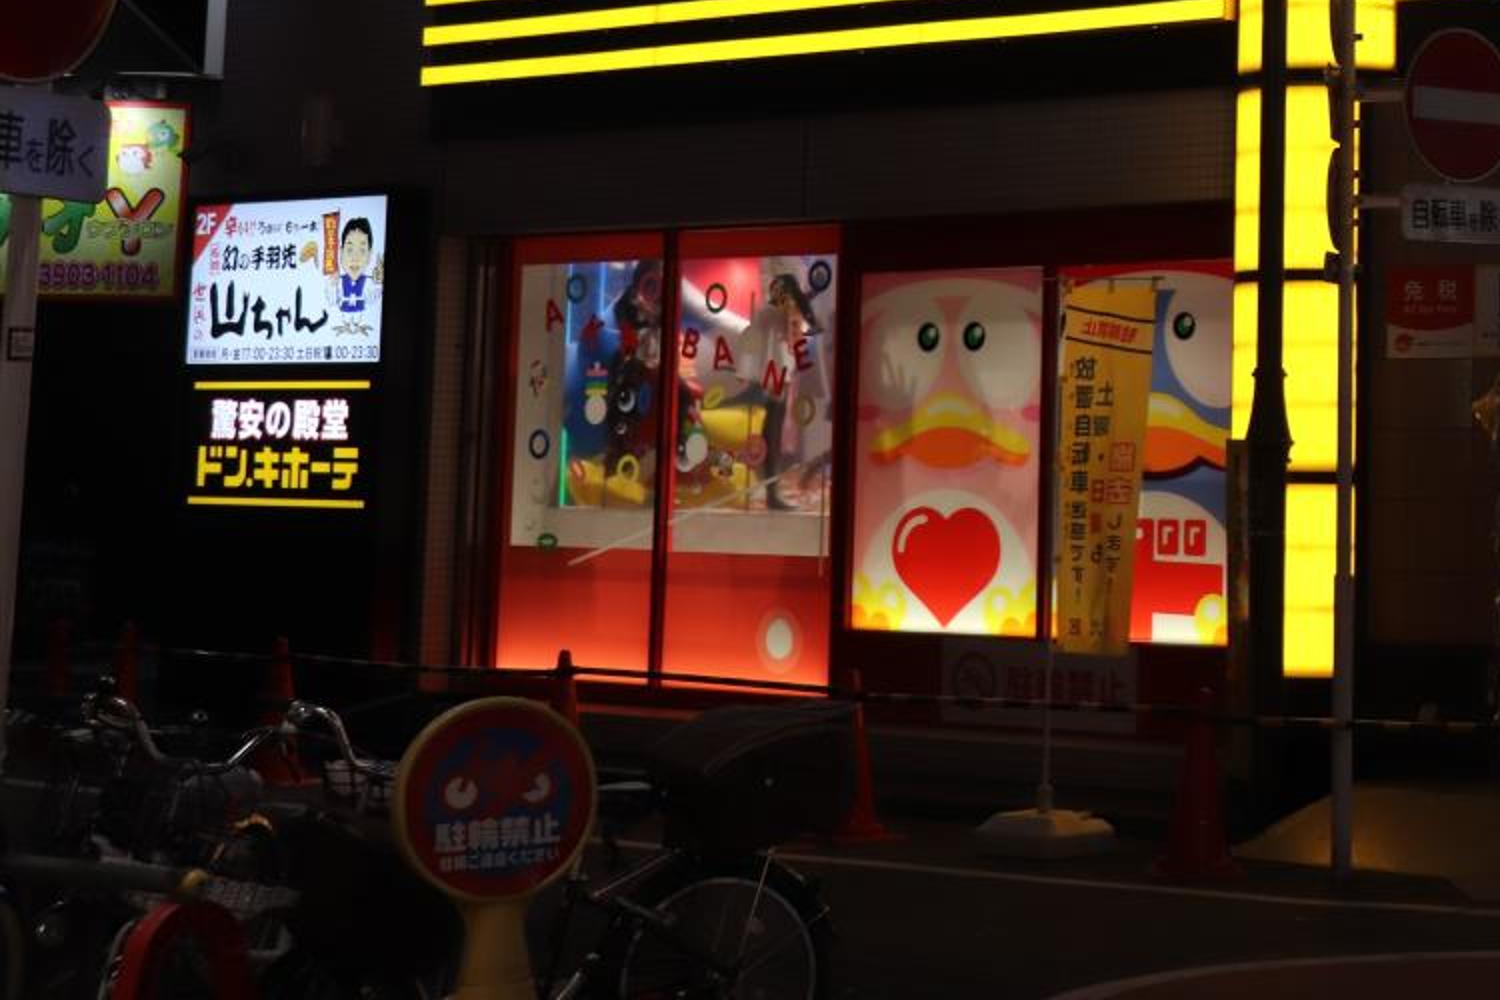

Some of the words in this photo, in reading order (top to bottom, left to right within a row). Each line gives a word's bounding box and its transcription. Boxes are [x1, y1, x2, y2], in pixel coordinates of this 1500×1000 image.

[196, 211, 217, 235] 2F
[222, 243, 297, 272] 幻の手羽先
[210, 280, 329, 340] 山ちゃん
[210, 399, 349, 440] 驚安の殿堂
